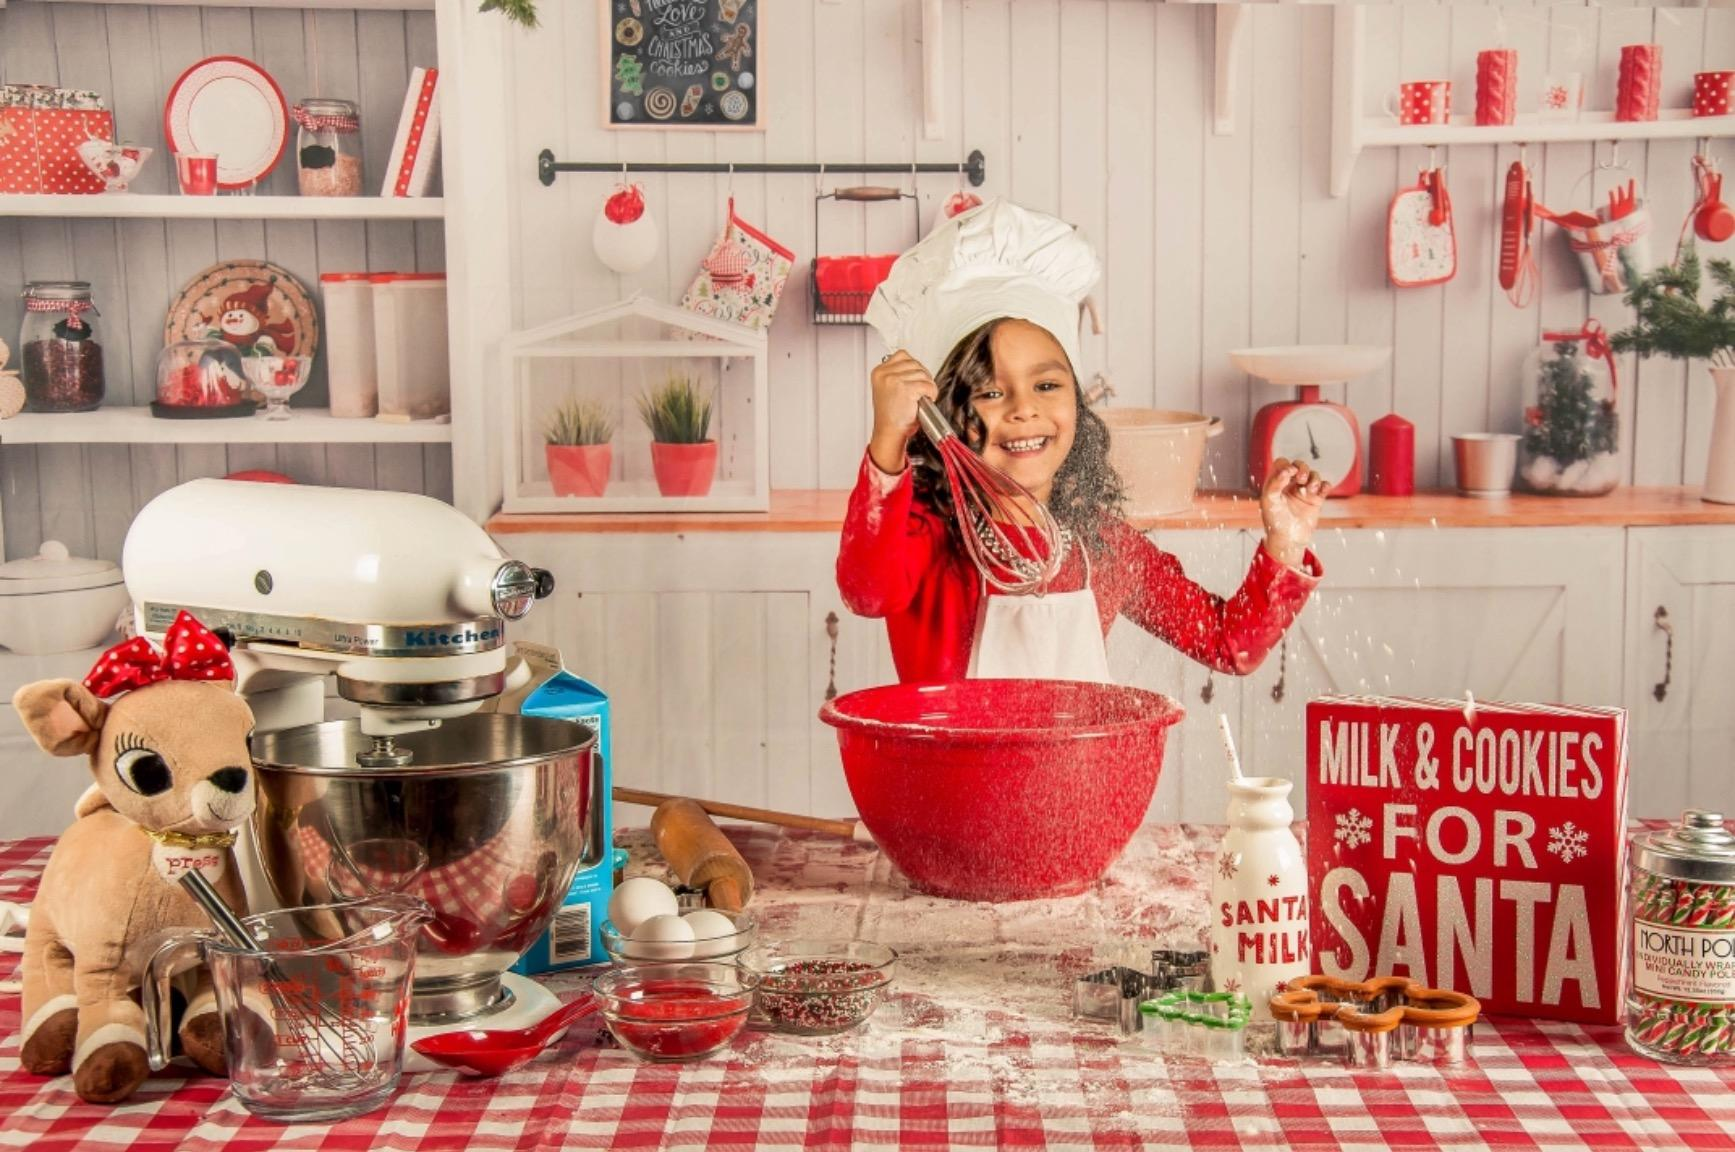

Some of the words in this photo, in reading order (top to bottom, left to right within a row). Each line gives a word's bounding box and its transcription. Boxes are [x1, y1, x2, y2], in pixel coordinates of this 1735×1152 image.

[404, 627, 499, 647] Kitchen
[1319, 719, 1403, 789] MILK
[1414, 722, 1440, 791] &
[1452, 726, 1604, 800] COOKIES
[1382, 802, 1539, 869] FOR
[1220, 894, 1307, 928] SANTA
[1237, 929, 1309, 965] MILK
[1319, 866, 1602, 1010] SANTA
[1640, 929, 1695, 957] NORTH
[1636, 950, 1703, 970] INDIVIDUALLY
[1645, 961, 1666, 974] MINI
[1668, 966, 1707, 979] CANDY
